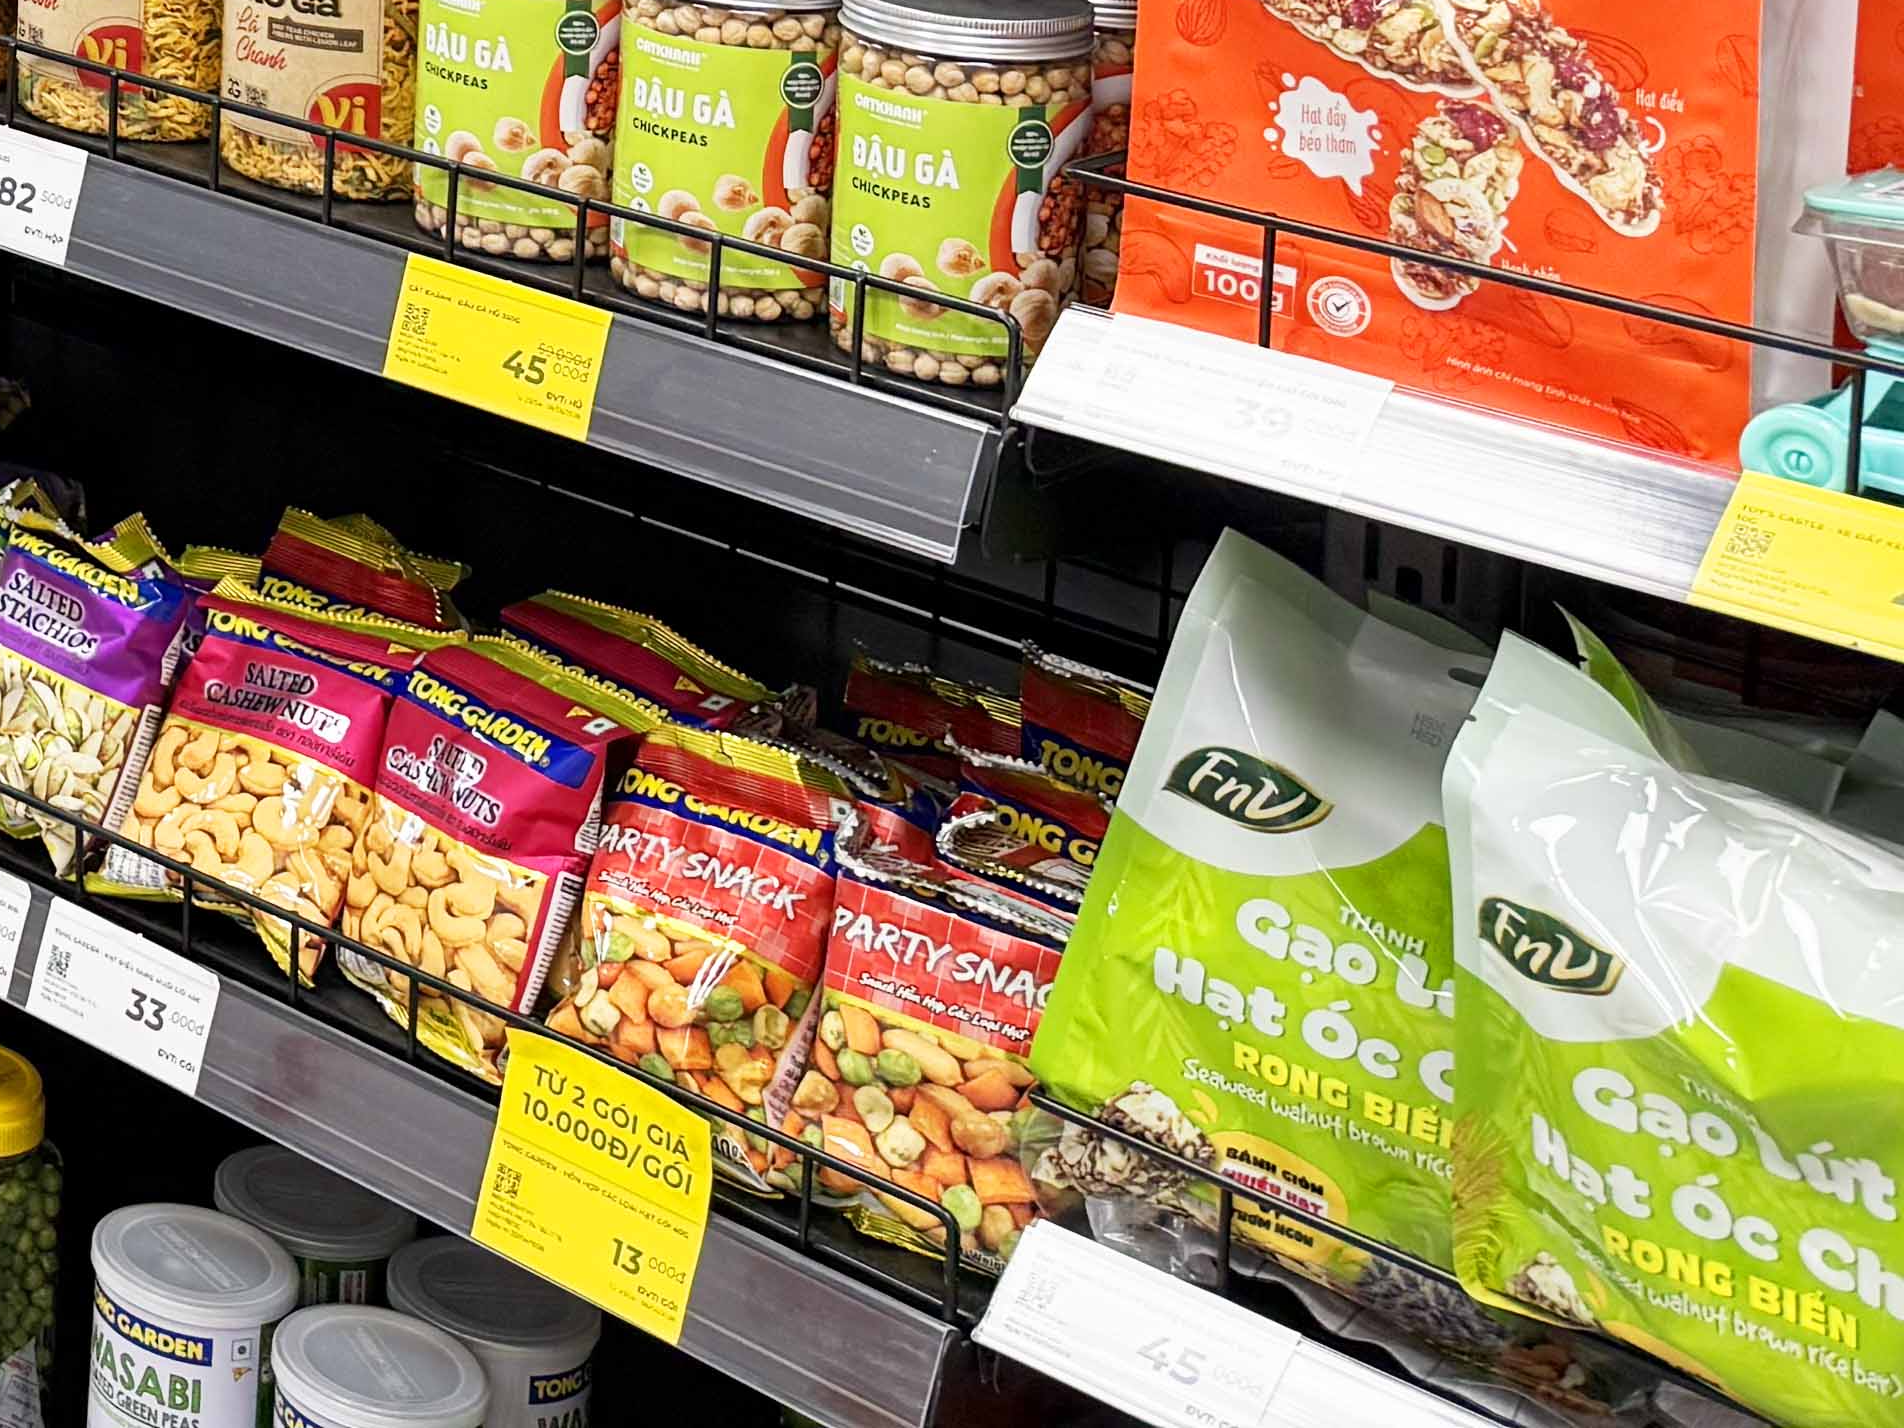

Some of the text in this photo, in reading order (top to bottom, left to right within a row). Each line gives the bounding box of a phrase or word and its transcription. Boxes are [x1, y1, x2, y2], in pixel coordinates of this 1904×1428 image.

[236, 38, 287, 72] Chanh
[632, 117, 709, 147] CHICKPEAS
[694, 89, 736, 129] GÀ
[852, 176, 932, 210] CHICKPEAS
[503, 350, 547, 385] 45
[8, 569, 83, 622] SALTED
[244, 662, 314, 695] SALTED
[407, 673, 547, 763] TONG GARDEN
[1184, 751, 1307, 823] FnV
[685, 852, 808, 919] SNACK
[834, 906, 943, 970] PARTY
[1234, 899, 1373, 987] Gạo
[125, 988, 165, 1031] 33
[1154, 949, 1399, 1078] Hạt Óc
[1233, 1043, 1348, 1110] RONG
[534, 1065, 689, 1161] TỪ 2 GÓI GIÁ
[1266, 1091, 1414, 1160] walnut brown
[612, 1238, 642, 1275] 13
[1602, 1224, 1859, 1349] RONG BIỂN
